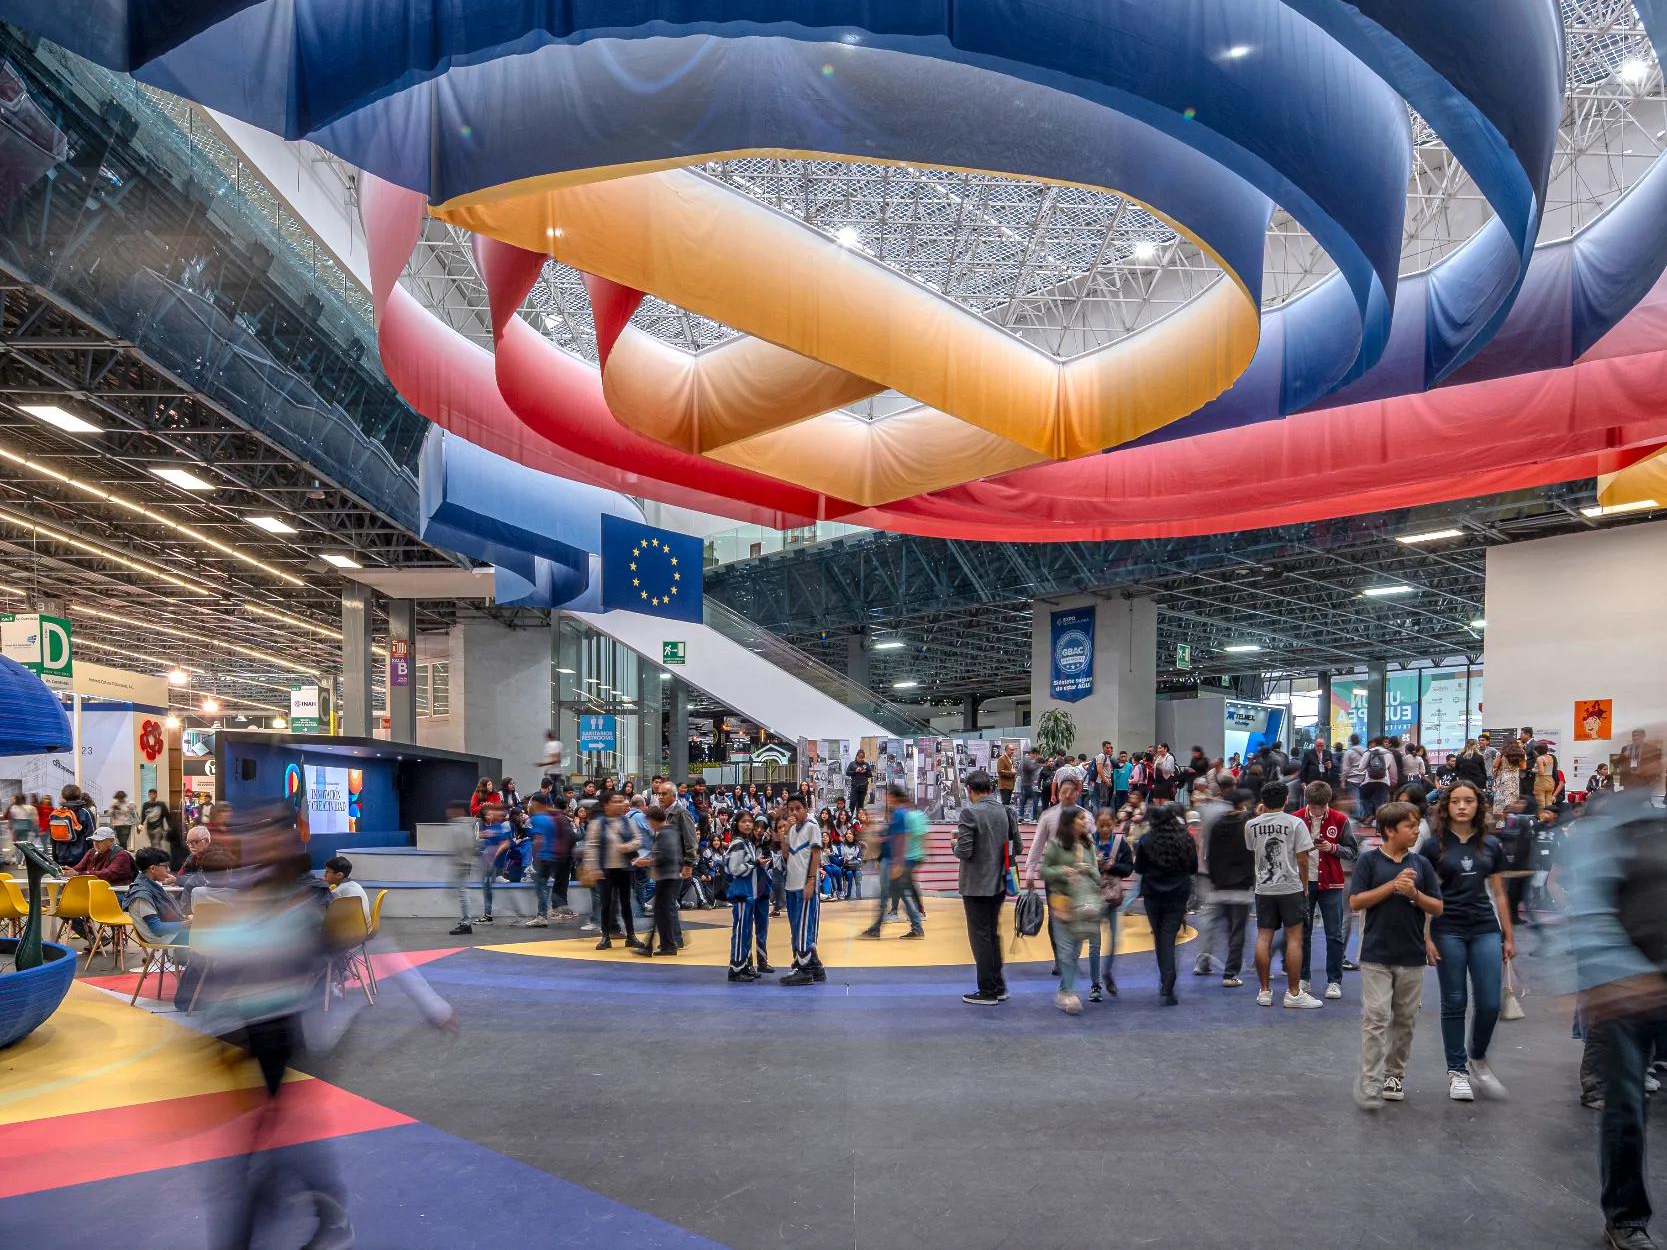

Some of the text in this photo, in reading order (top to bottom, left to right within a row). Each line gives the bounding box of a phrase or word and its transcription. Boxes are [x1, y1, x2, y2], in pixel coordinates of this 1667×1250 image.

[42, 622, 70, 669] D
[1062, 646, 1084, 657] GBAC
[398, 662, 408, 675] B
